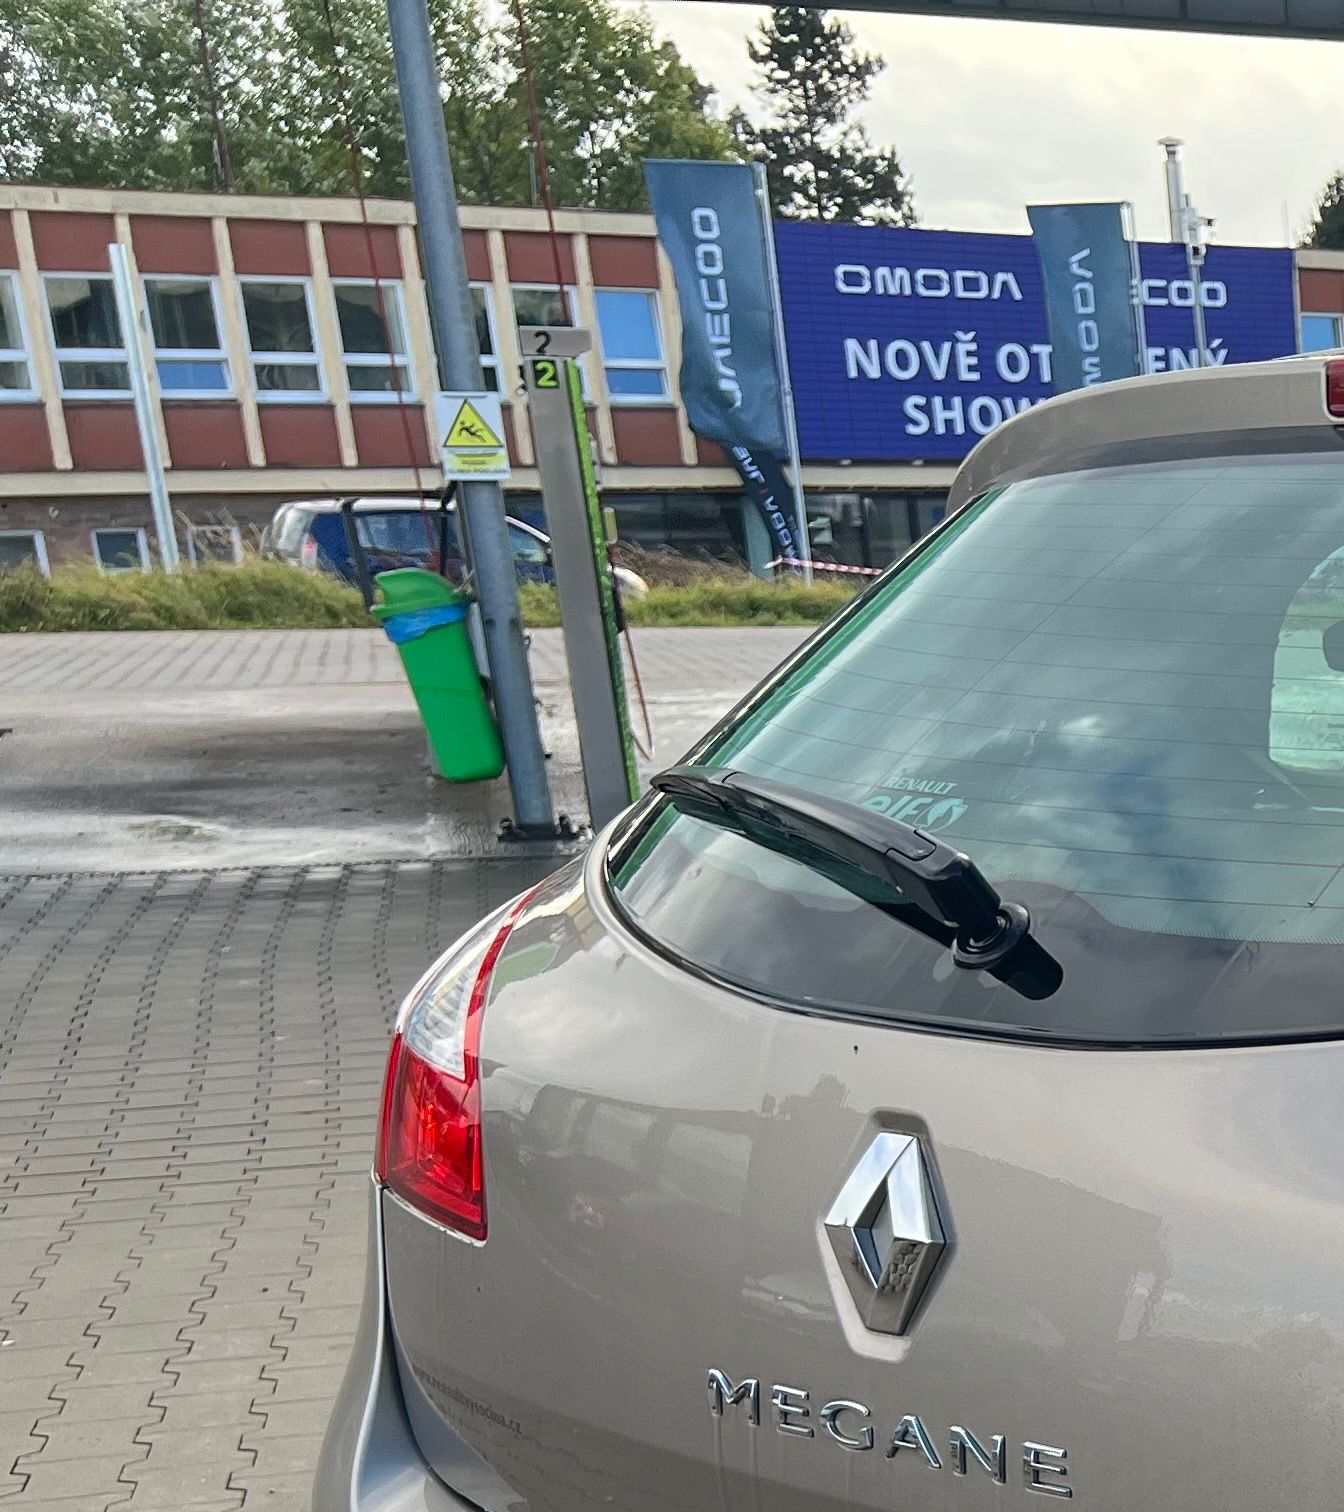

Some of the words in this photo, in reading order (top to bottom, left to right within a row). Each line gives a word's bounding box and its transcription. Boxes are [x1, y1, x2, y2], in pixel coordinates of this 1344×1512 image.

[834, 264, 1023, 301] OMODA
[1131, 278, 1227, 308] COO
[1068, 248, 1102, 386] MODA
[533, 331, 552, 353] 2
[844, 330, 981, 382] NOVĚ
[535, 361, 558, 389] 2
[882, 776, 960, 795] RENAULT
[707, 1368, 1073, 1498] MEGANE
